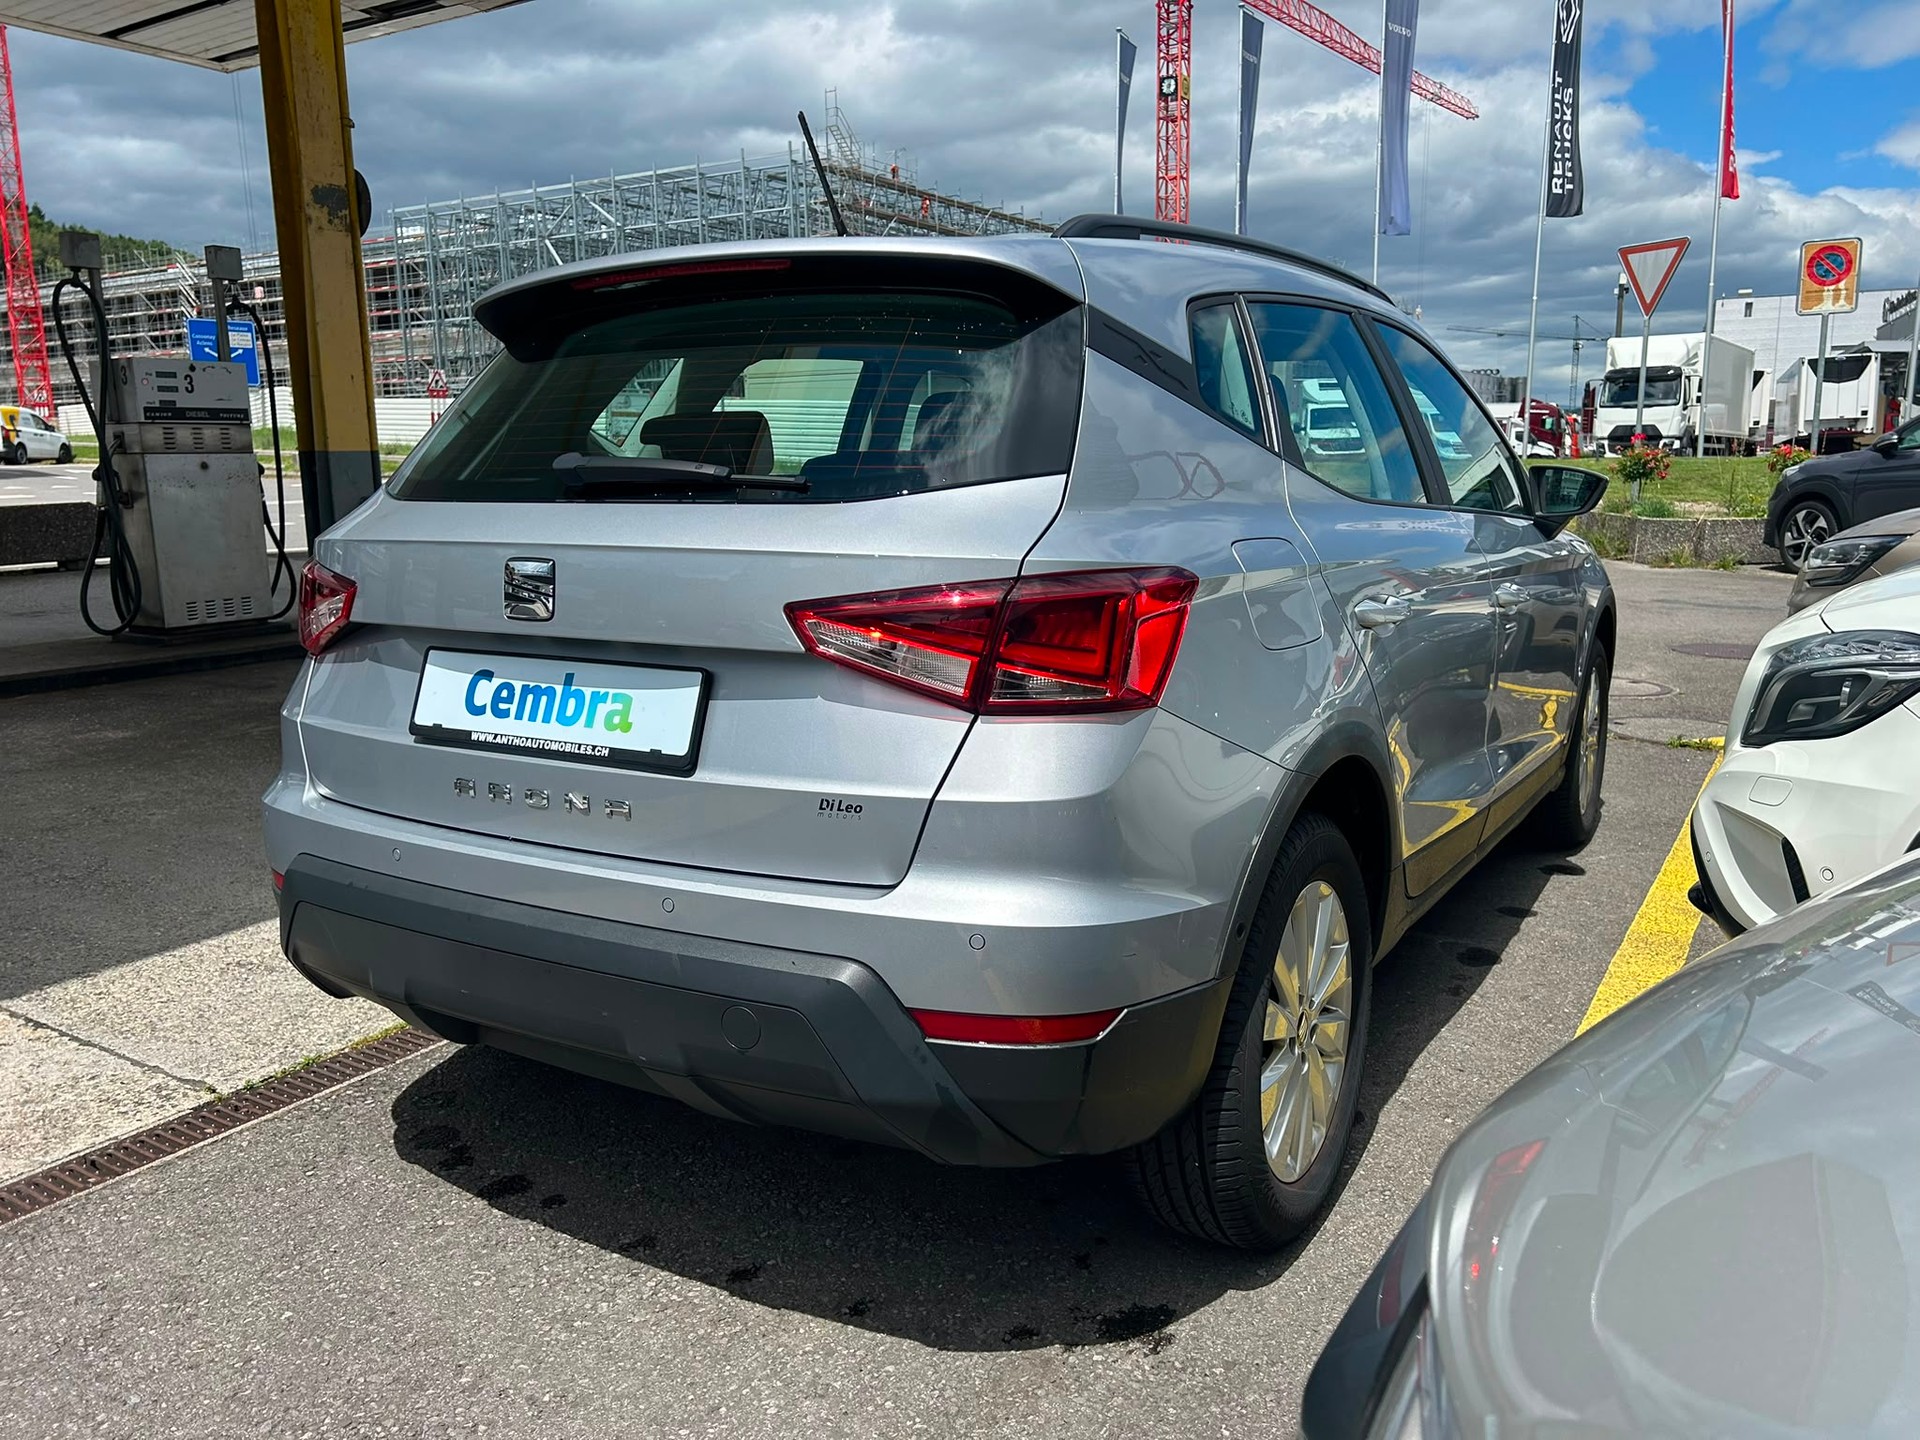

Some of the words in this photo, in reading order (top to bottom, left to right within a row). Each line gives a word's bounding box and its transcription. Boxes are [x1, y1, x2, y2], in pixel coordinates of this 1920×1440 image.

[1388, 22, 1411, 37] VOLVO
[1552, 70, 1563, 194] RENAULT
[1562, 87, 1574, 194] TRUCKS
[120, 365, 128, 386] 3
[183, 374, 195, 394] 3
[465, 668, 633, 734] Cembra
[470, 731, 610, 757] WWW.ANTHOAUTOMOBILES.CH
[453, 777, 632, 822] ARONA
[818, 798, 836, 812] Di
[836, 799, 863, 814] Leo
[816, 811, 862, 820] motors
